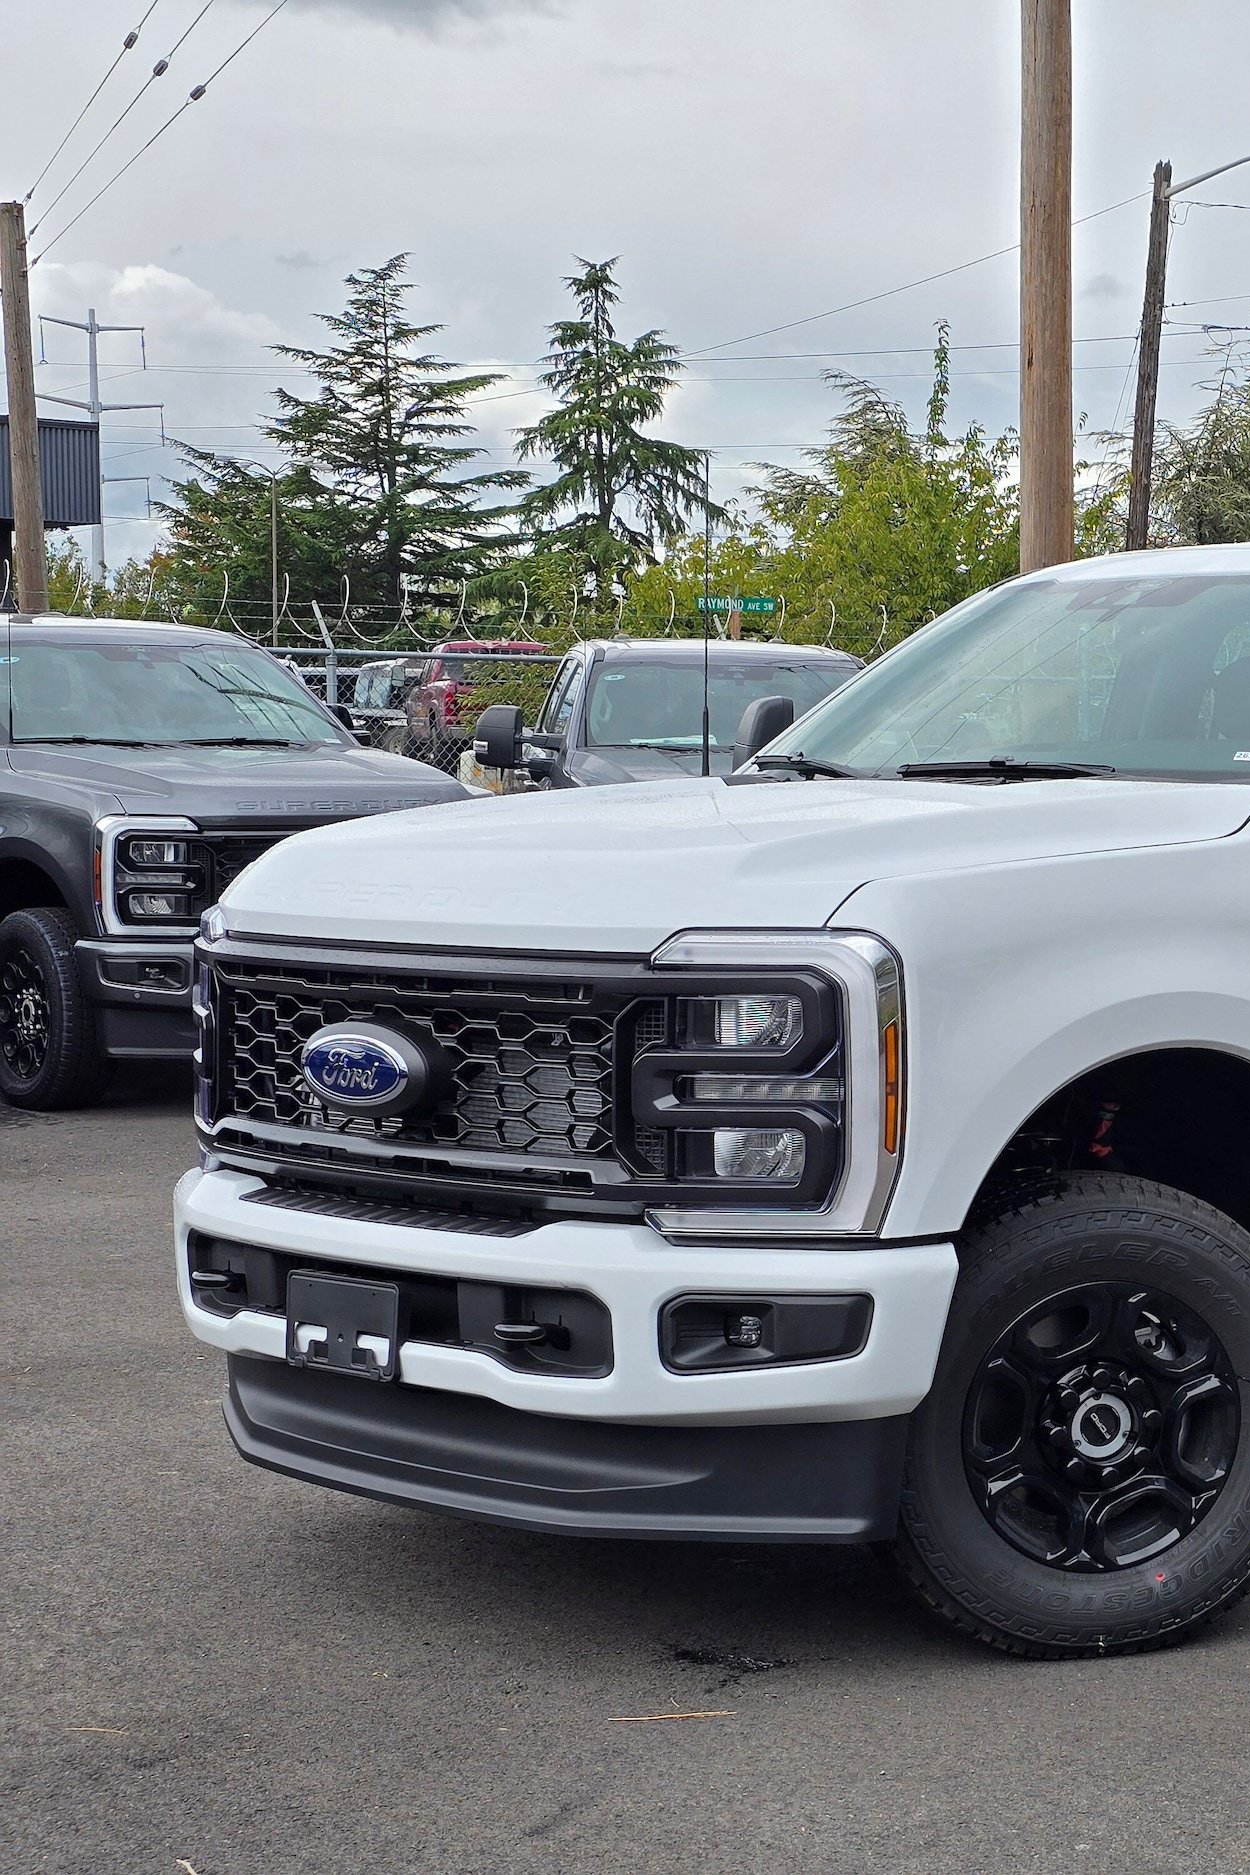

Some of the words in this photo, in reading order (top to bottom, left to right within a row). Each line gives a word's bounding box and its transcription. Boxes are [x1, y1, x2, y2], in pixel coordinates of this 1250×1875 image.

[698, 598, 744, 610] RAYMOND
[747, 602, 760, 611] AVE
[763, 602, 774, 611] SW
[234, 800, 357, 811] SUPER
[322, 1047, 380, 1091] Ford
[1090, 1412, 1111, 1440] FORD
